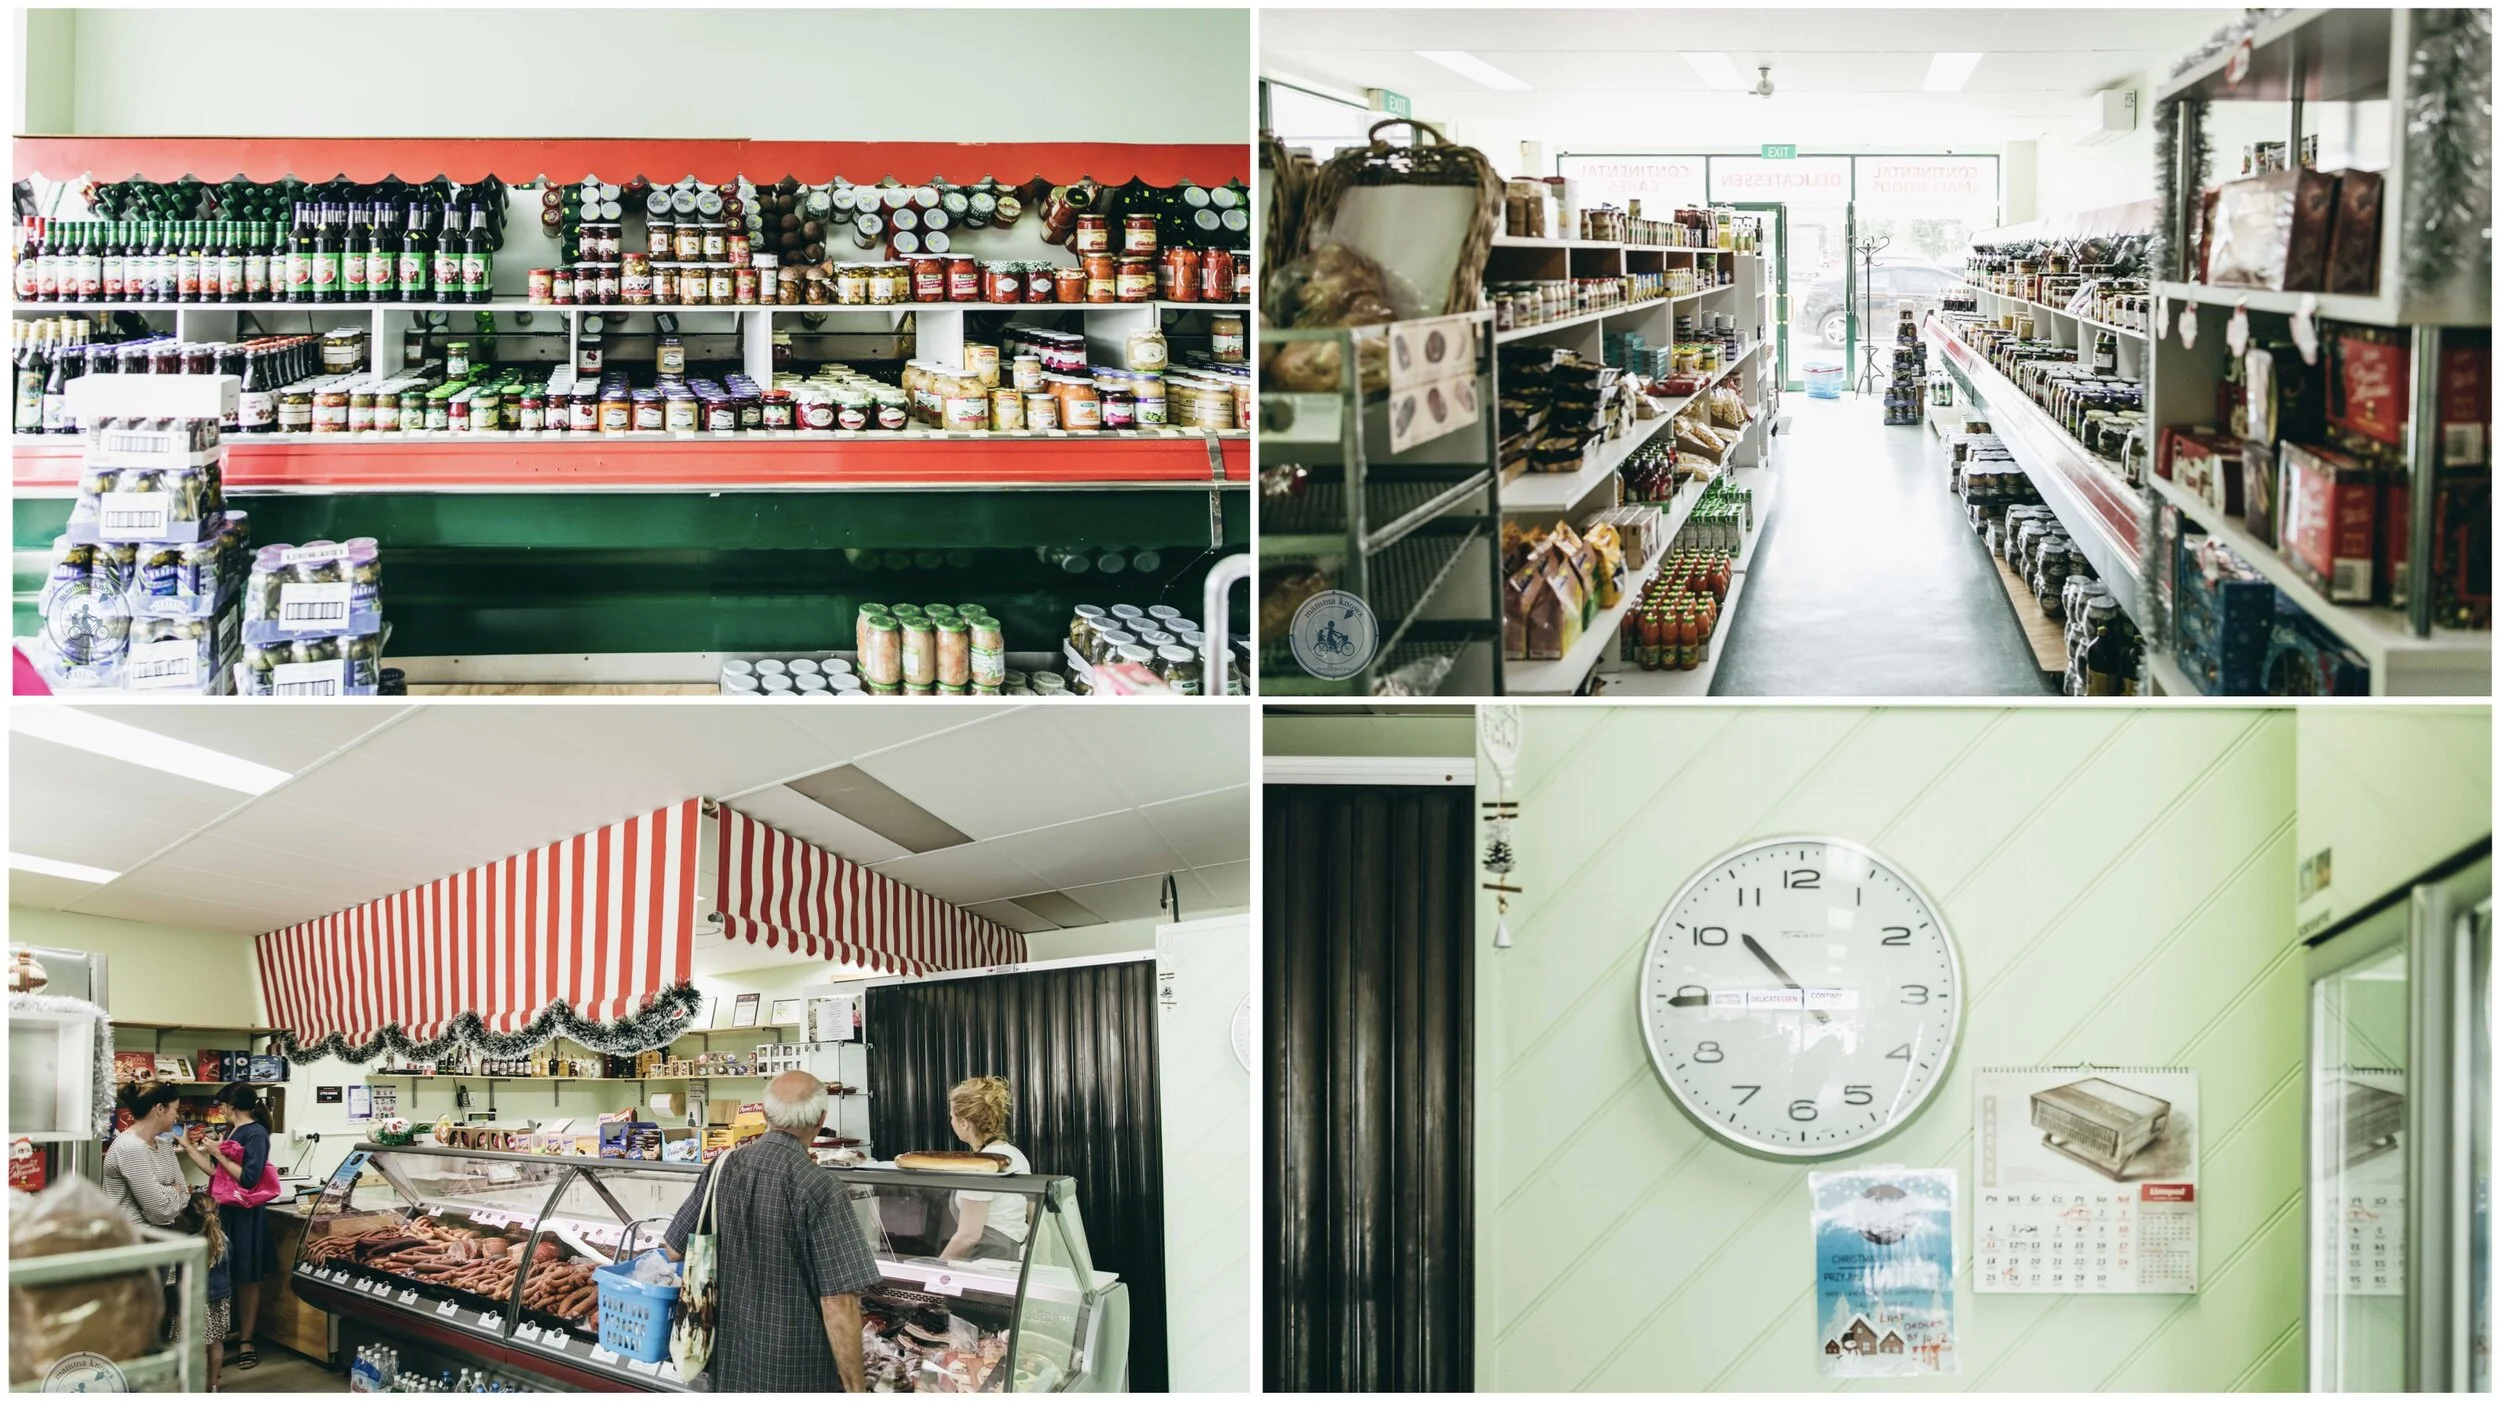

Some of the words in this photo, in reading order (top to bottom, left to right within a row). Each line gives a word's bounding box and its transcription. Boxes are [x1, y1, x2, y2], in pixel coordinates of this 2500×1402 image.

[1389, 95, 1407, 116] EXIT
[1768, 146, 1790, 158] EXIT
[1783, 869, 1821, 889] 12
[1738, 887, 1760, 907] 11
[1693, 926, 1729, 946] 10
[1881, 926, 1912, 946] 2
[1750, 995, 1799, 1004] DELICATESSEN
[1900, 985, 1929, 1005] 3
[1693, 1041, 1724, 1063] 8
[1885, 1043, 1912, 1063] 4
[1731, 1085, 1761, 1106] 7
[1844, 1085, 1873, 1106] 5
[1788, 1100, 1819, 1122] 6
[1831, 1253, 1879, 1265] CHRISTMA
[1879, 1312, 1905, 1323] LAST
